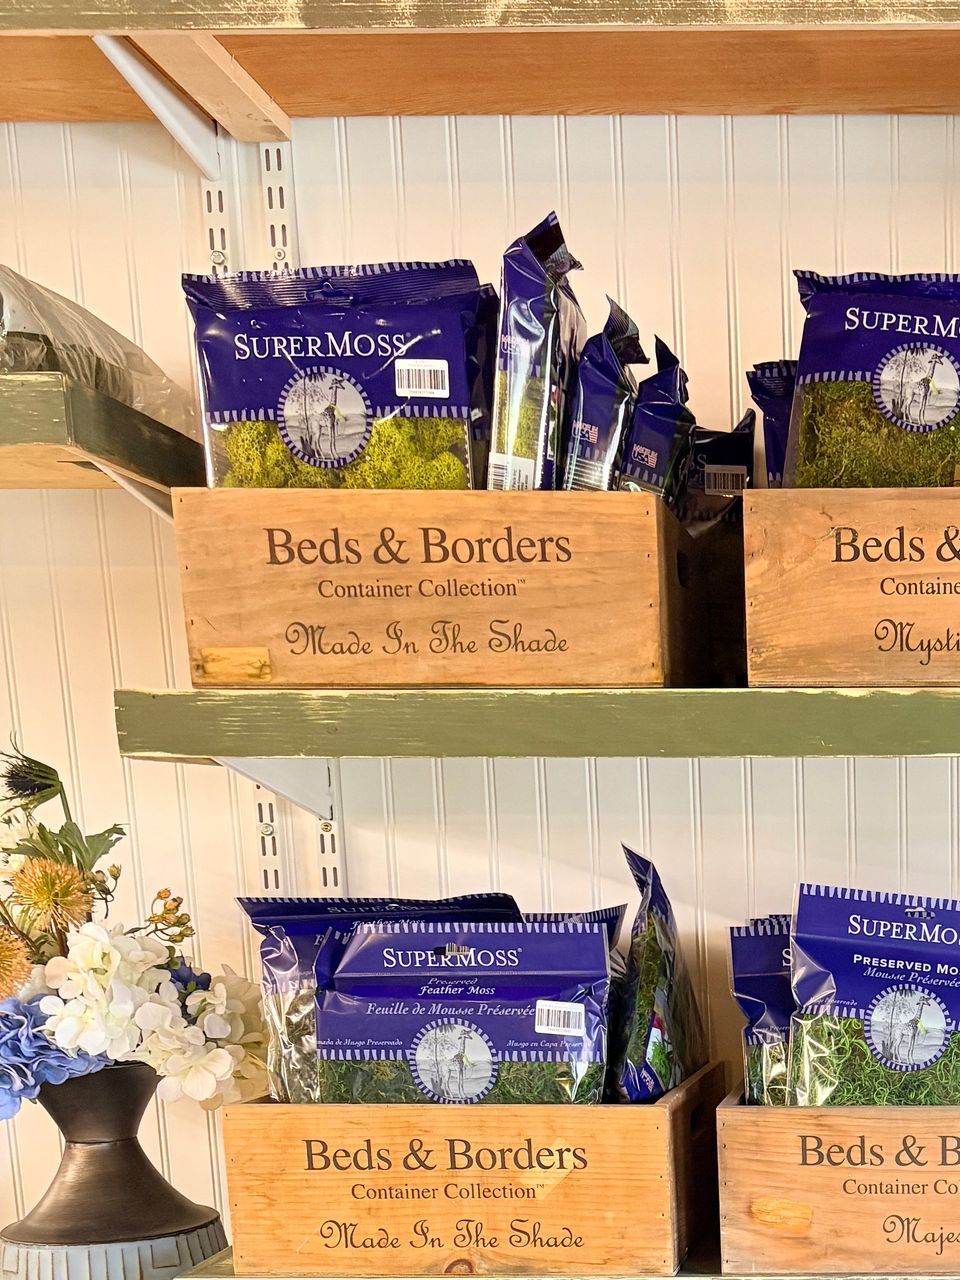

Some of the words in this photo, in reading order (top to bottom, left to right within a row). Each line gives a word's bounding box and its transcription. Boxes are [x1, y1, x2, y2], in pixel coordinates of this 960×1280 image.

[233, 331, 407, 361] SUPERMOSS
[265, 527, 362, 566] Beds
[373, 526, 410, 565] &
[418, 526, 573, 564] Borders
[832, 525, 925, 563] Beds
[317, 579, 412, 599] Container
[285, 621, 373, 656] Made
[382, 621, 419, 655] In
[429, 620, 478, 654] The
[488, 619, 569, 653] Shade
[853, 954, 931, 972] PRESERVED
[863, 968, 907, 981] Mousse
[909, 972, 960, 988] Préservée
[418, 986, 463, 996] Feather
[467, 986, 495, 995] Moss
[366, 1003, 409, 1016] Feuille
[412, 1004, 425, 1015] de
[428, 1004, 474, 1016] Mousse
[478, 1004, 535, 1016] Préservée
[304, 1139, 392, 1172] Beds
[402, 1138, 437, 1170] &
[445, 1138, 588, 1171] Borders
[799, 1136, 884, 1167] Beds
[895, 1135, 928, 1166] &
[351, 1184, 438, 1201] Container
[842, 1179, 928, 1196] Container
[320, 1220, 400, 1249] Made
[409, 1220, 444, 1249] In
[453, 1219, 498, 1249] The
[509, 1219, 584, 1249] Shade
